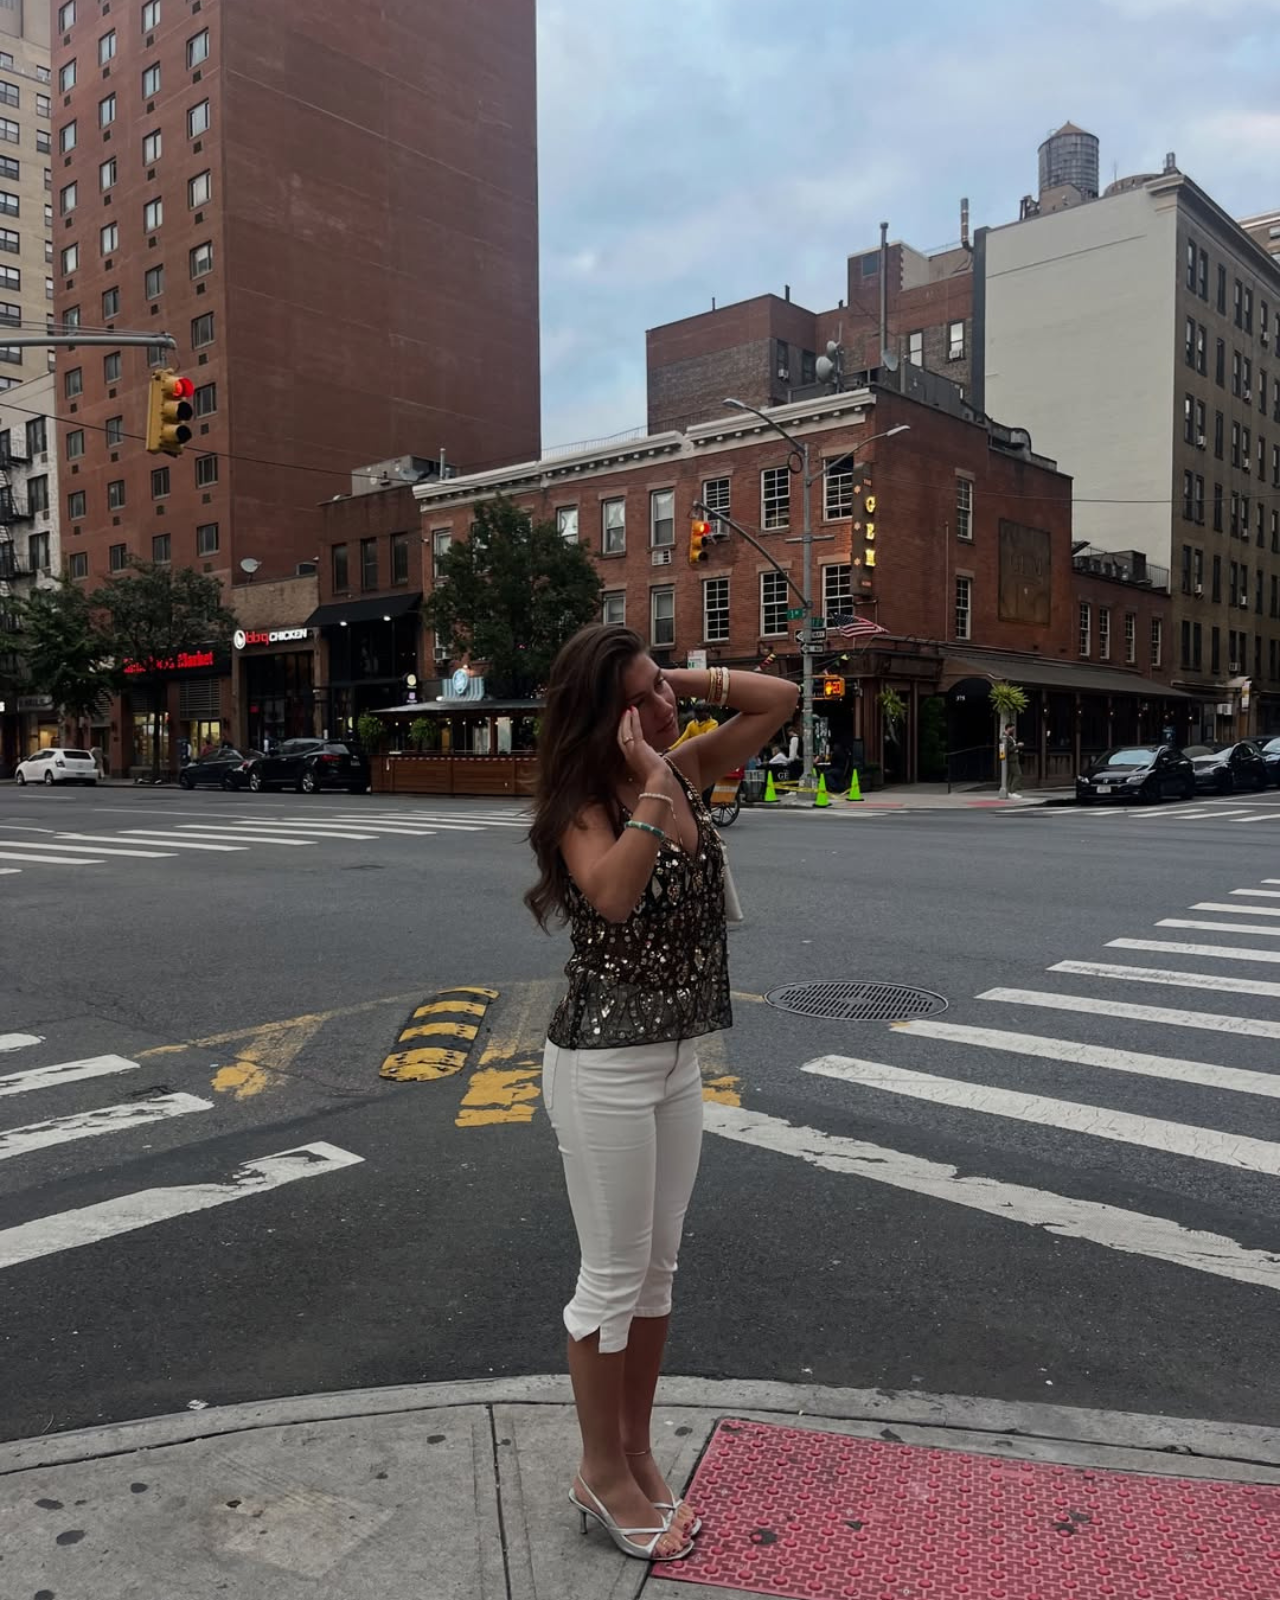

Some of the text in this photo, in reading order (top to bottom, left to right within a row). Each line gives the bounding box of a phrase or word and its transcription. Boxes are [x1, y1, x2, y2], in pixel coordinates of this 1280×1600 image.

[865, 496, 876, 566] GEM
[245, 628, 308, 646] bbq CHICKEN
